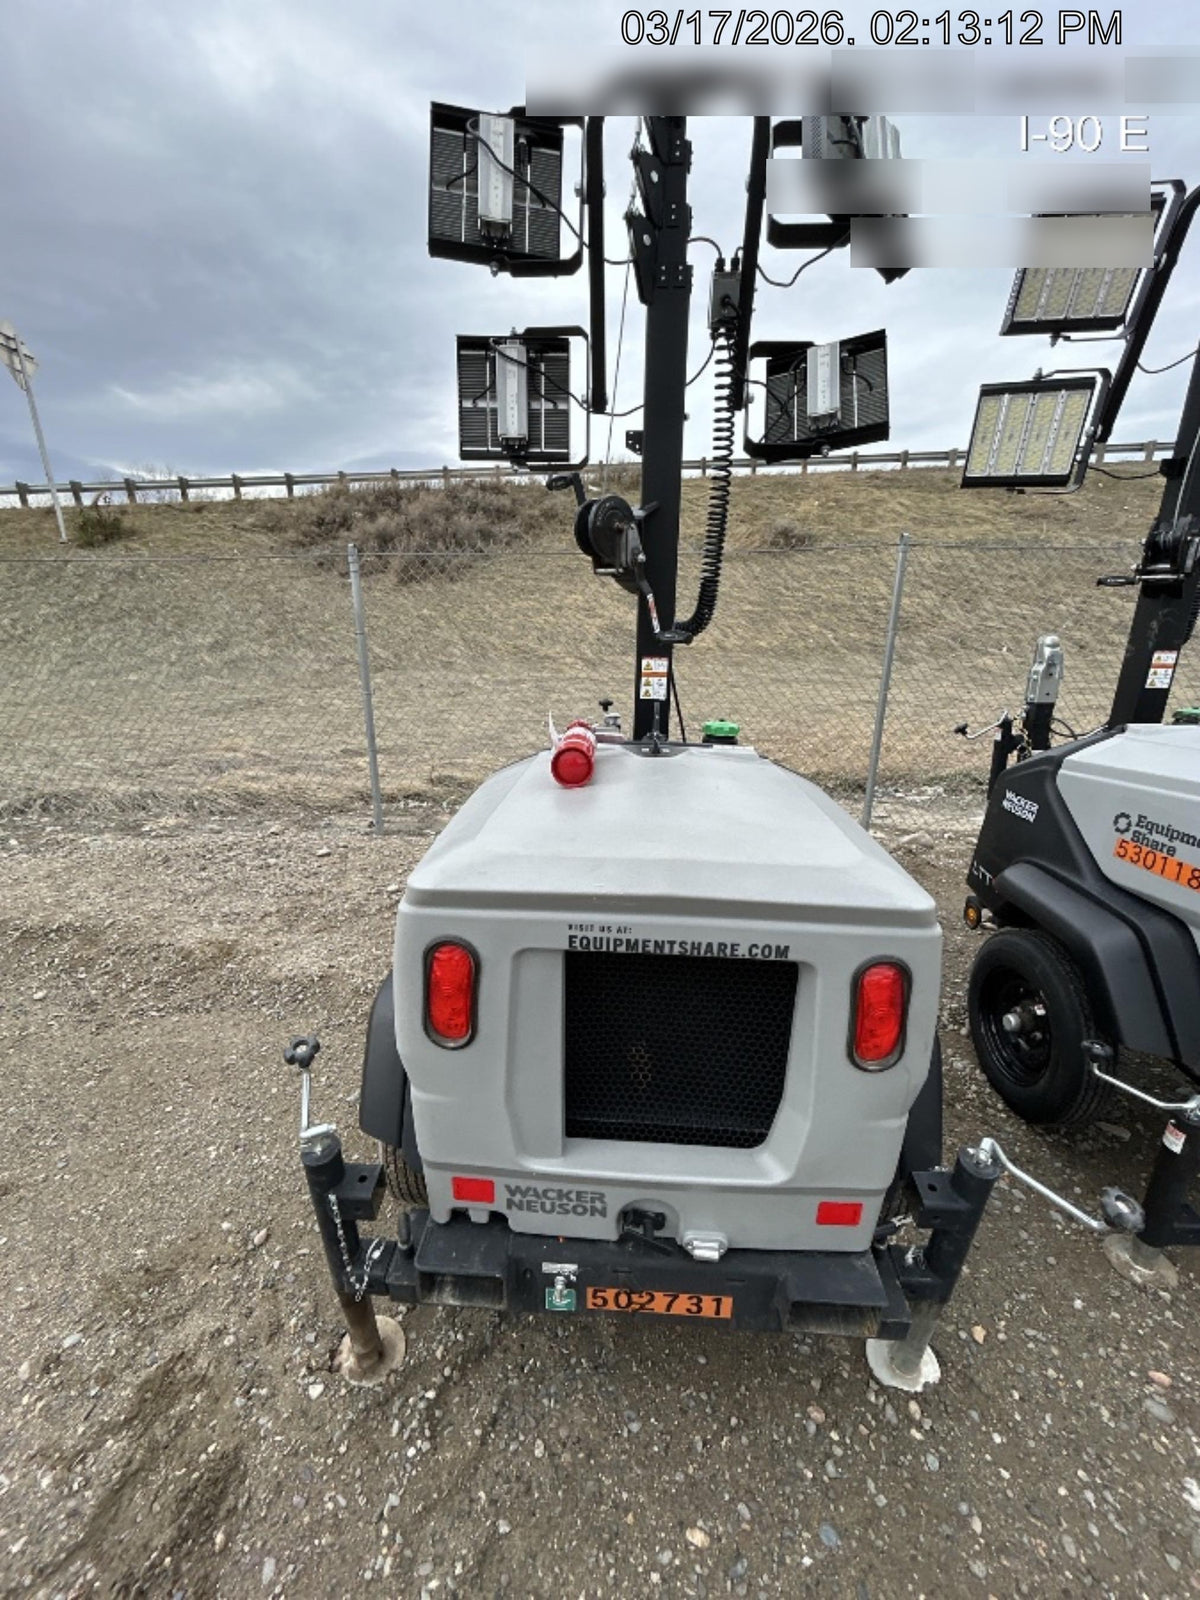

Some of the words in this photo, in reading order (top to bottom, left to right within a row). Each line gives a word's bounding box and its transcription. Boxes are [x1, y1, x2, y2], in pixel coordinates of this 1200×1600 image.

[1131, 829, 1177, 857] Share
[1116, 839, 1200, 890] 530118
[568, 934, 790, 959] EQUIPMENTSHARE.COM
[504, 1184, 606, 1204] WACKER
[506, 1197, 607, 1218] NEUSON
[591, 1288, 725, 1317] 502731
